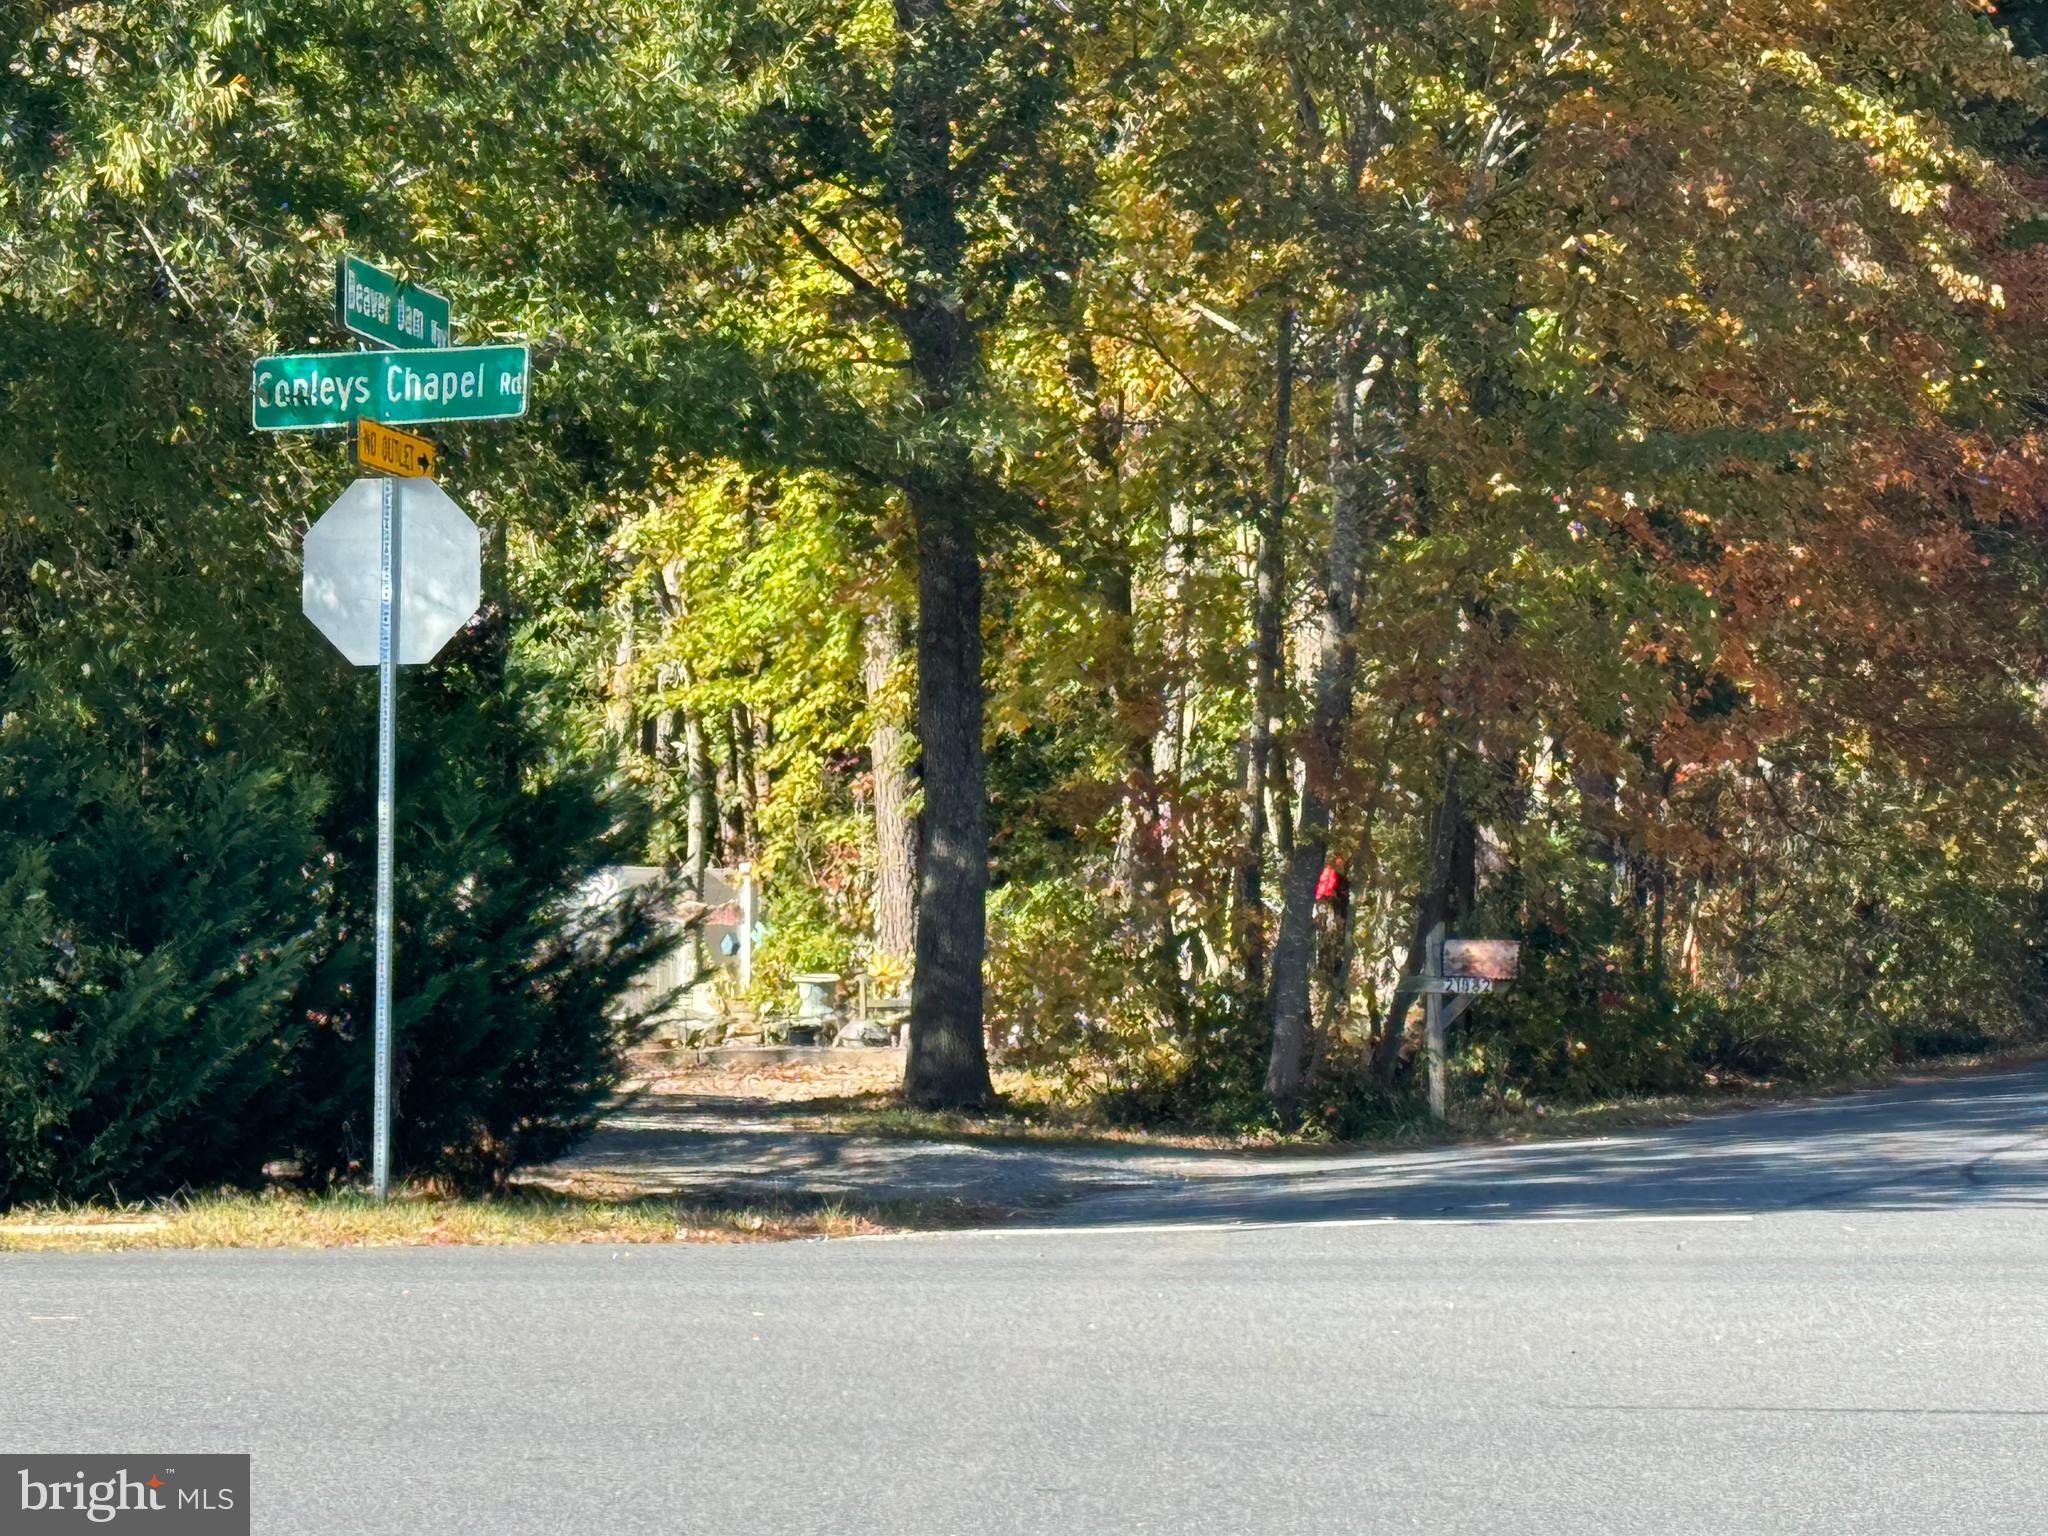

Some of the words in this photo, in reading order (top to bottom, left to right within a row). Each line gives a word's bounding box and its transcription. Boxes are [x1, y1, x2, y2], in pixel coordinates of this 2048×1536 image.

[347, 268, 391, 325] Beaver
[257, 369, 371, 411] Conleys
[386, 363, 485, 405] Chapel
[499, 371, 523, 396] Rd
[364, 431, 377, 457] NO
[382, 435, 414, 471] OUTLET
